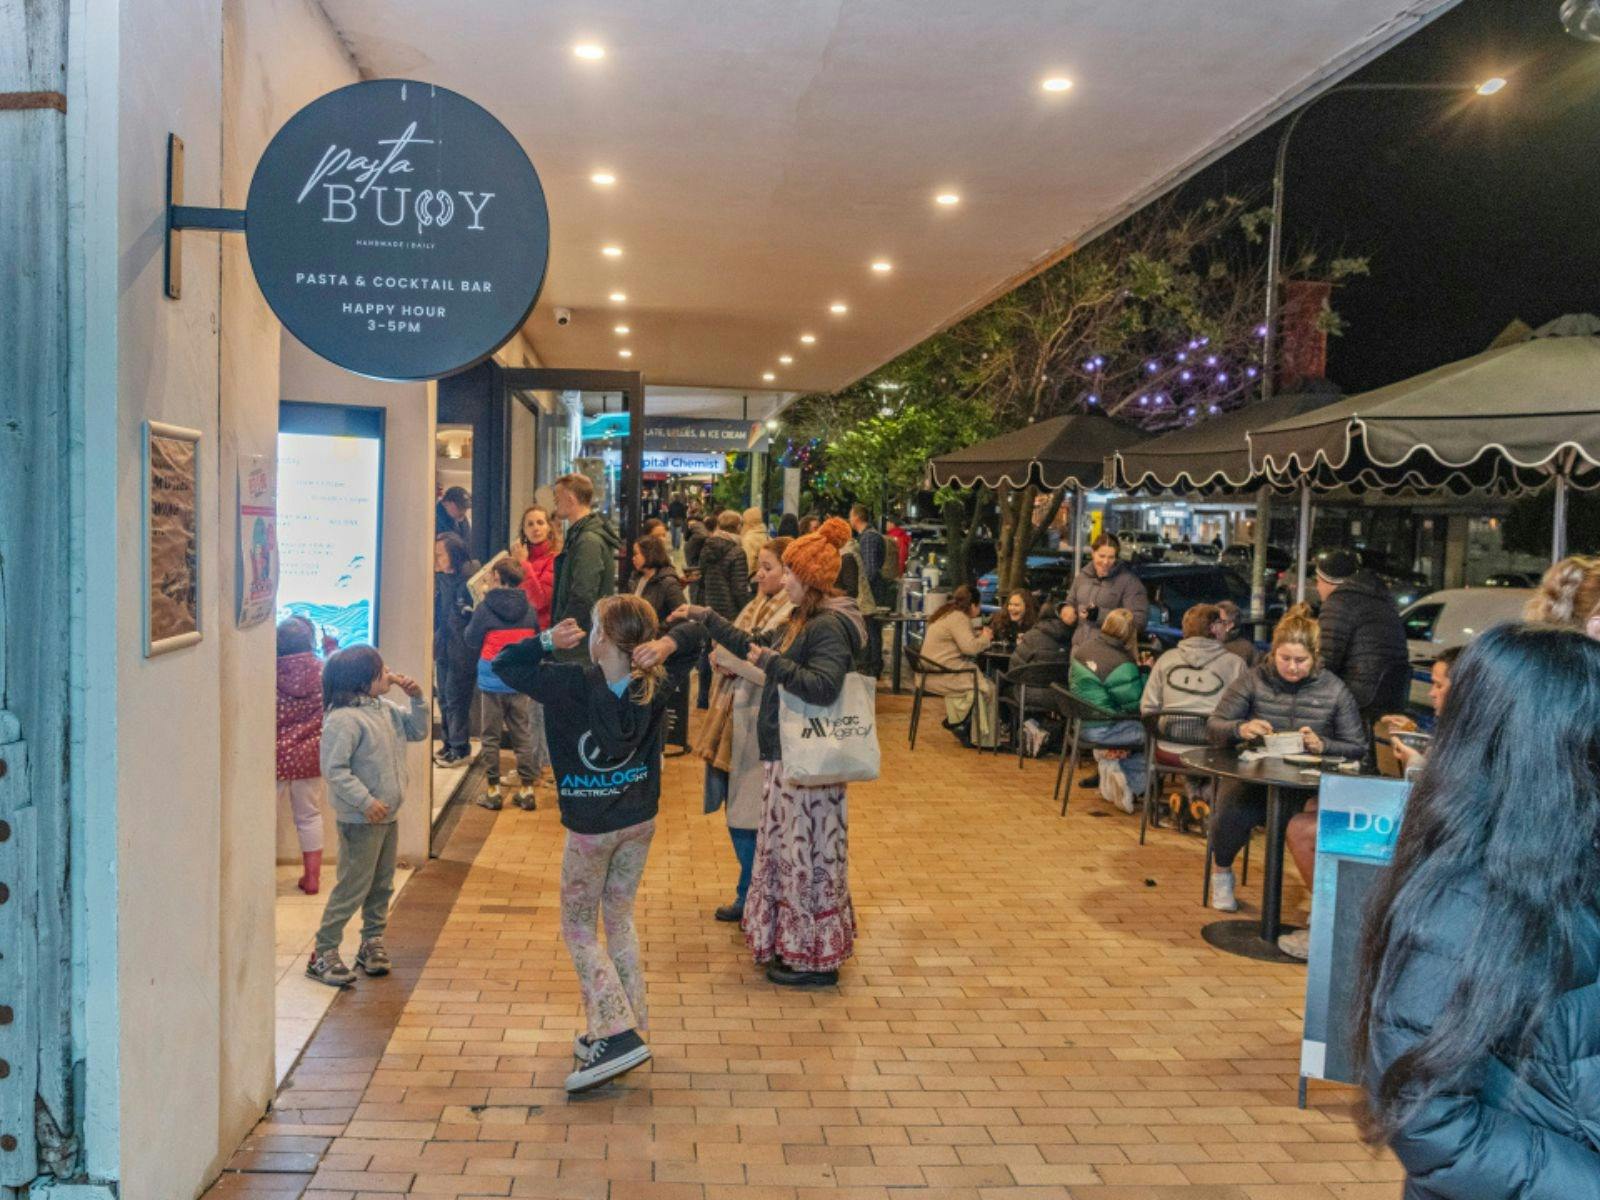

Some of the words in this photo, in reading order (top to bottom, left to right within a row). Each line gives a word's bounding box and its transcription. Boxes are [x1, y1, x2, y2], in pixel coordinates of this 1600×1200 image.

[297, 121, 435, 203] pasta
[355, 239, 405, 249] HANDMADE
[410, 242, 435, 250] DAILY
[296, 272, 349, 286] PASTA
[355, 275, 366, 287] &
[372, 276, 455, 292] COCKTAIL
[461, 280, 492, 293] BAR
[342, 302, 395, 316] HAPPY
[401, 304, 447, 318] HOUR
[367, 320, 421, 333] 3-5PM
[721, 430, 748, 440] CREAM
[641, 456, 669, 470] pital
[671, 457, 720, 470] Chemist
[1346, 806, 1395, 835] Do
